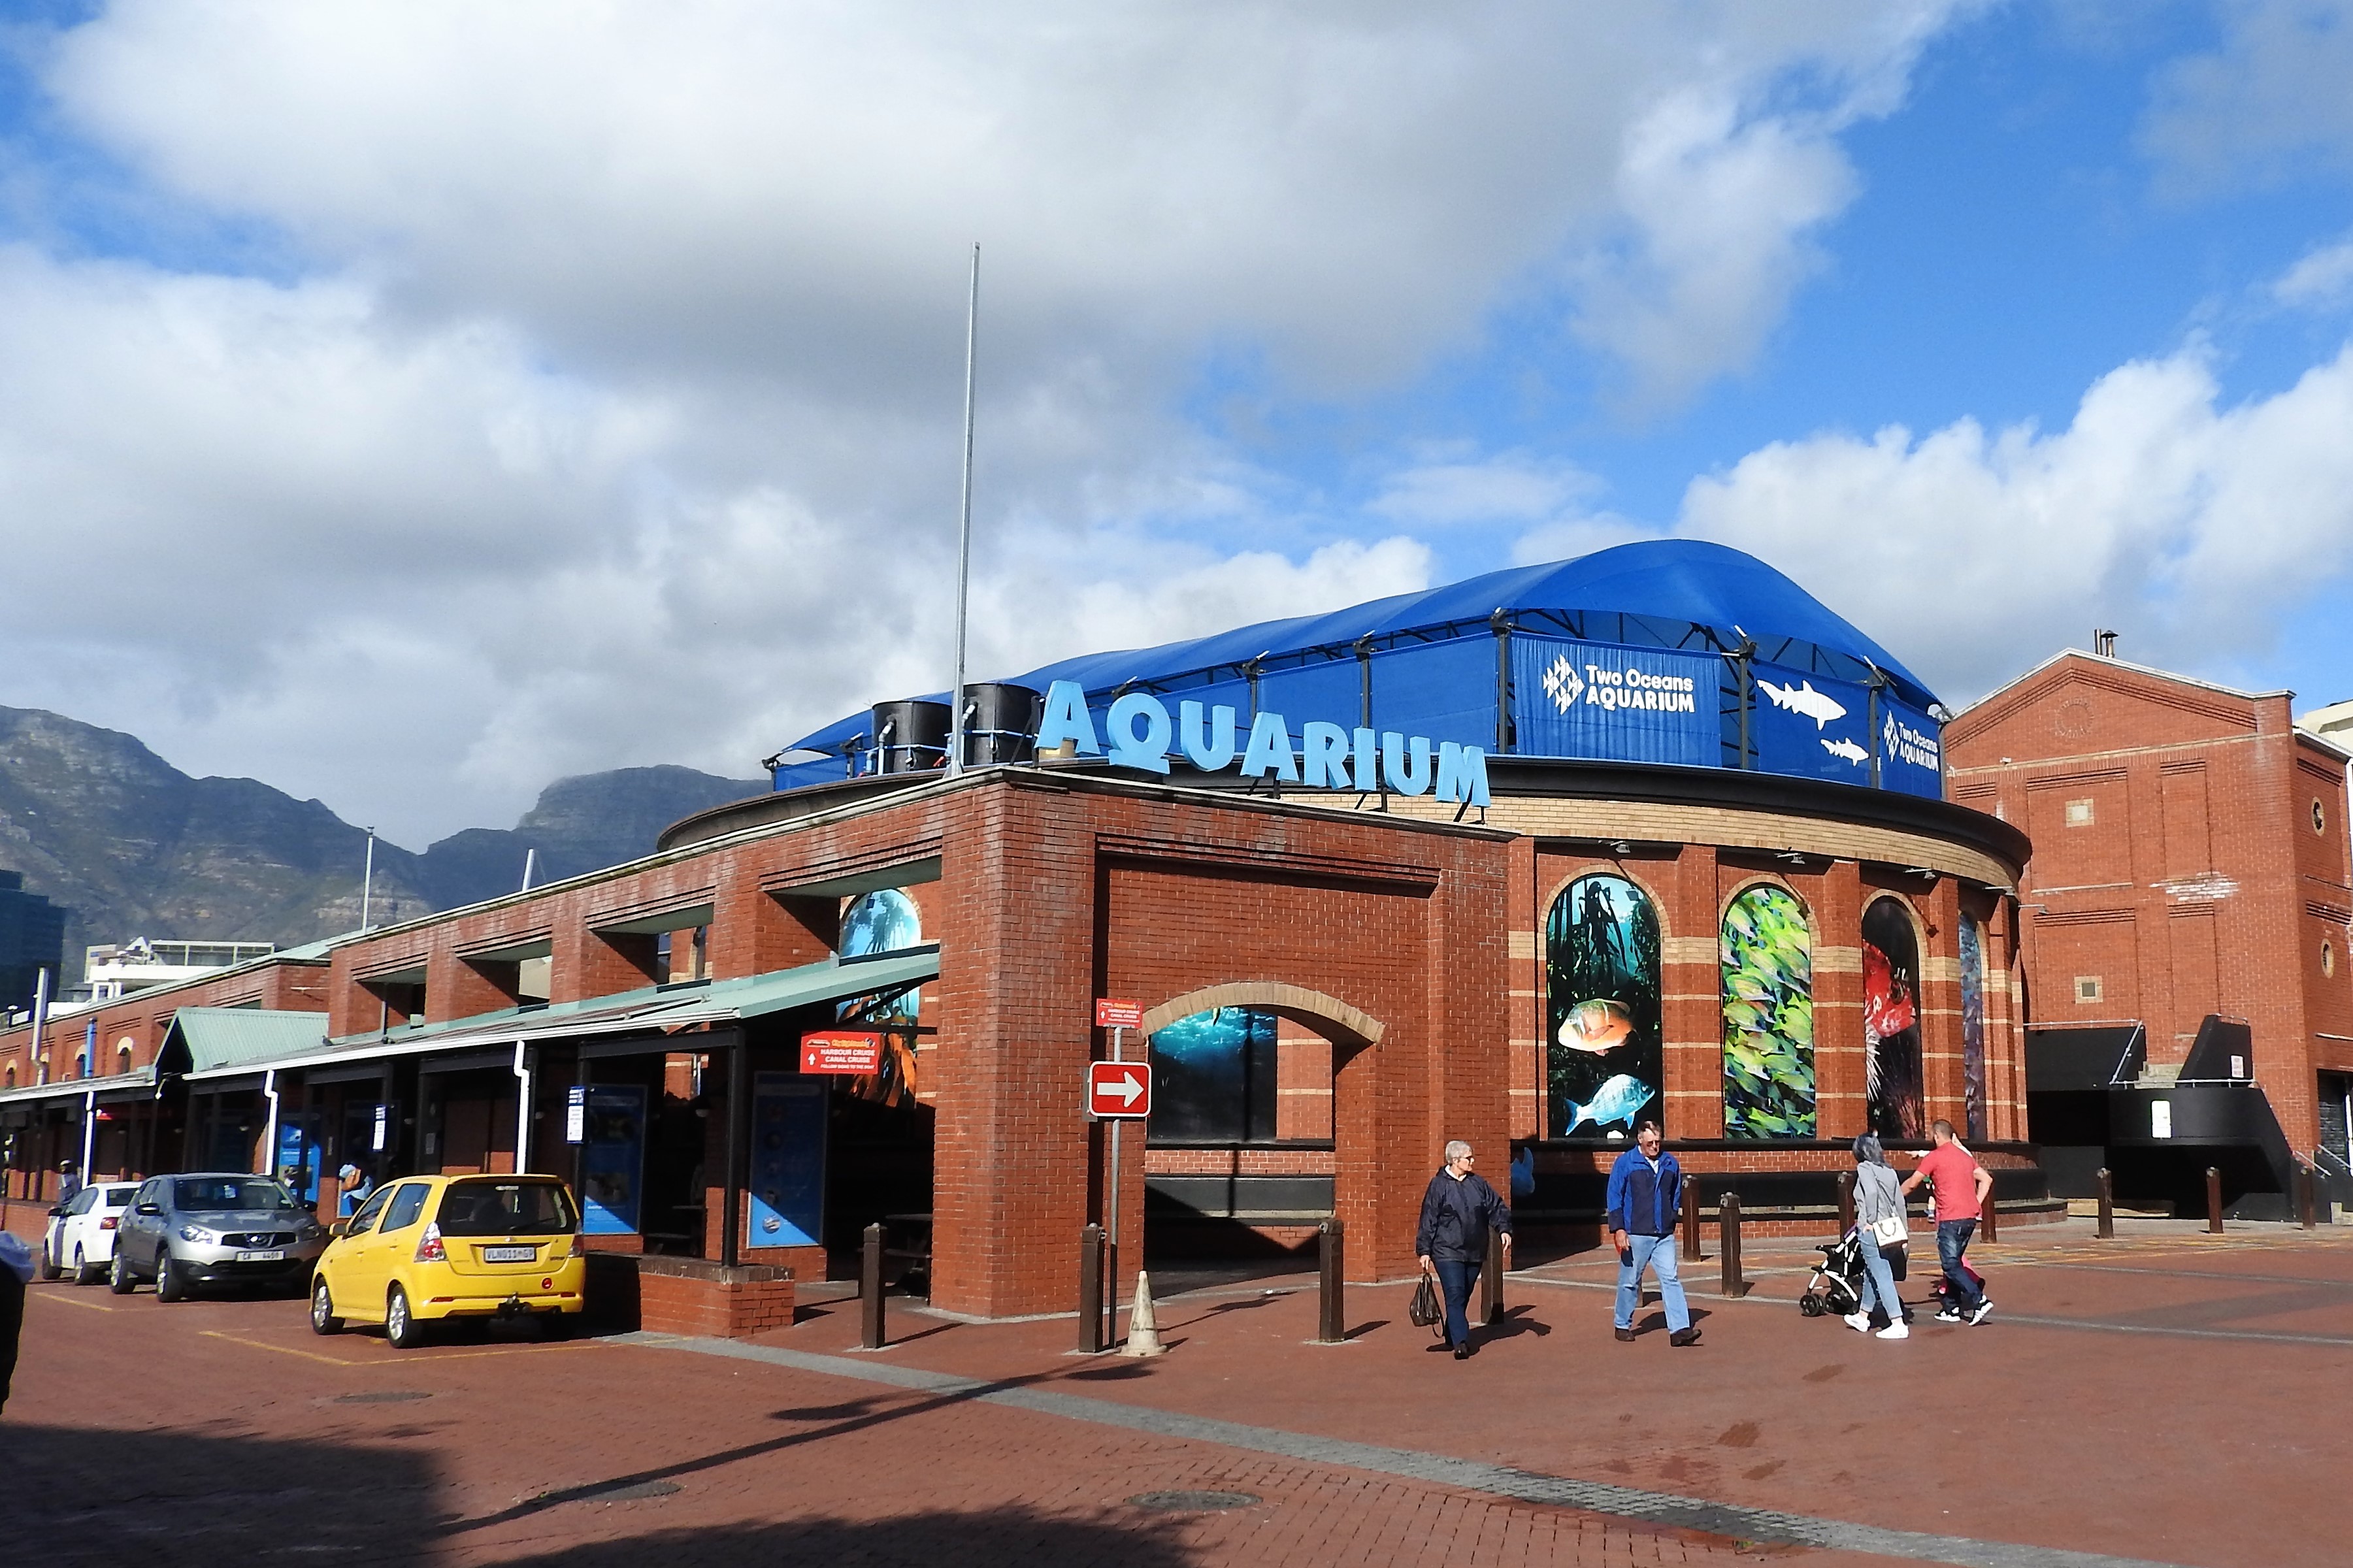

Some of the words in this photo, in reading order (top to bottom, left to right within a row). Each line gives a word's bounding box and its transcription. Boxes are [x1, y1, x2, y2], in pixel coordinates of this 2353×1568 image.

[1585, 664, 1622, 686] Two
[1626, 668, 1694, 692] Oceans
[1585, 685, 1695, 713] AQUARIUM
[1034, 679, 1490, 808] AQUARIUM
[1900, 740, 1939, 772] AQUARIUM
